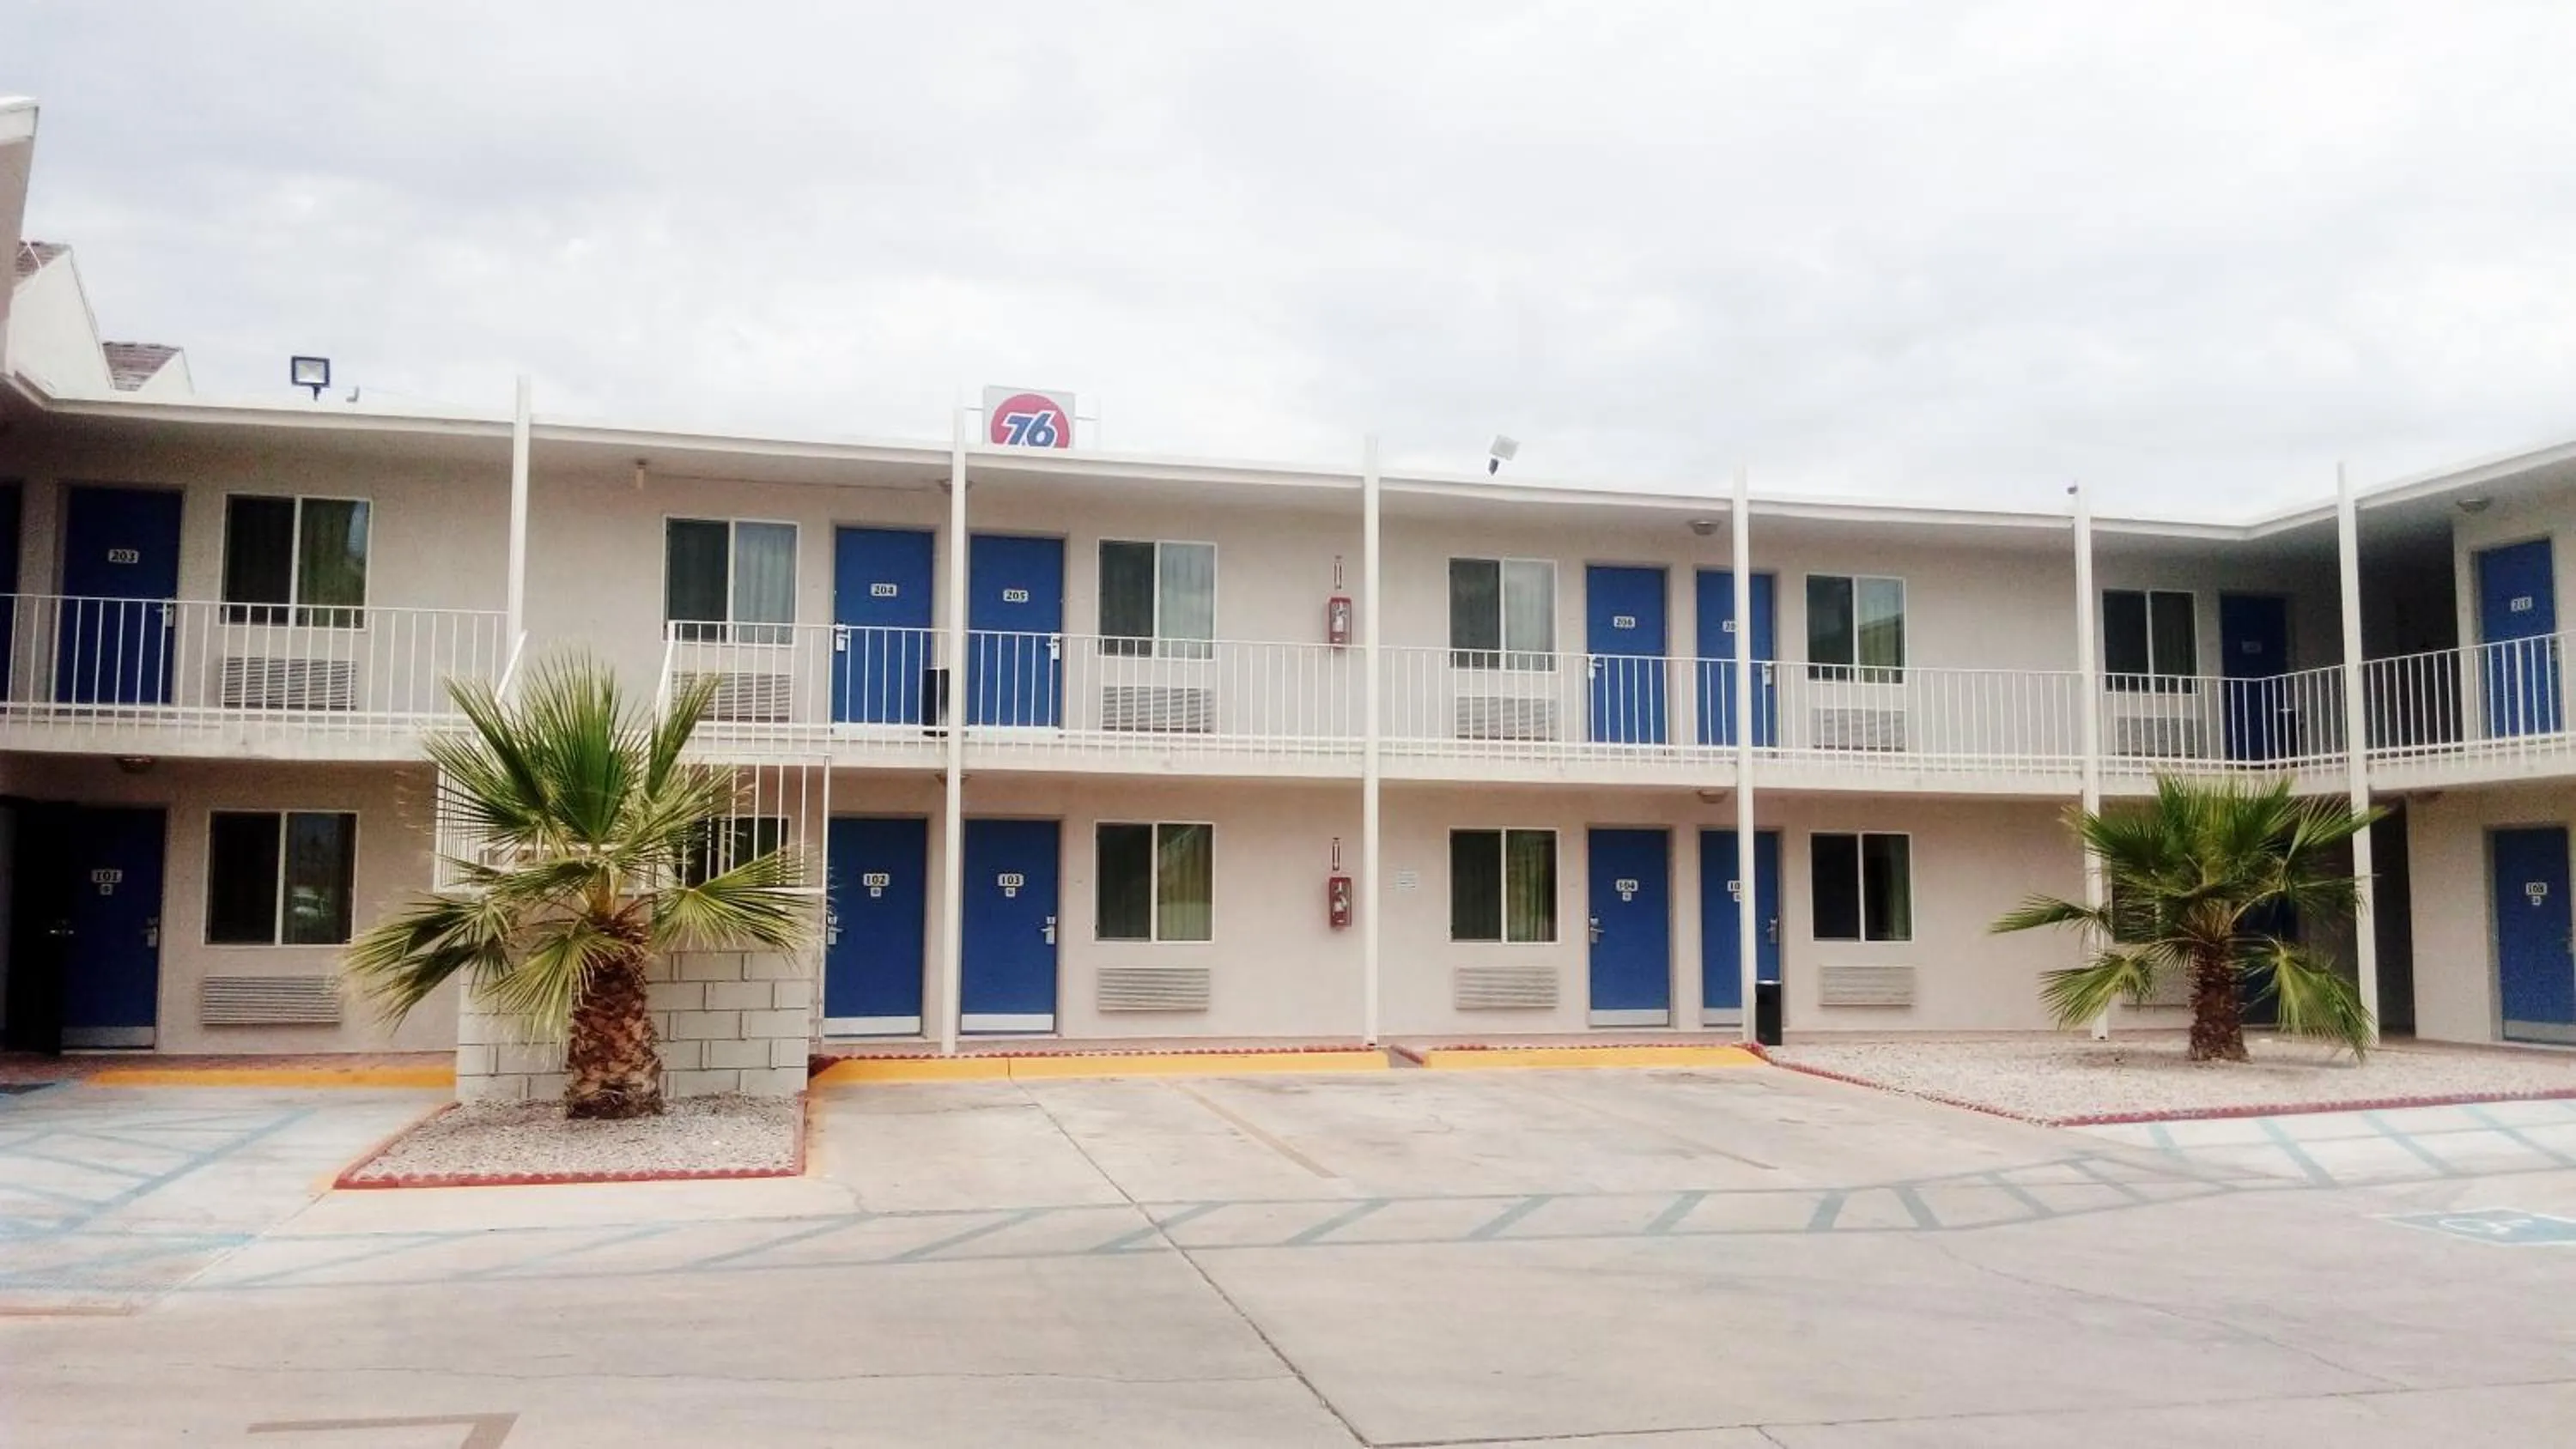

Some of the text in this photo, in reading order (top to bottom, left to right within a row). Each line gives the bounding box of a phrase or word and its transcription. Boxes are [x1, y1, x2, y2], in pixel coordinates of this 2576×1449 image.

[1003, 410, 1057, 447] 76
[112, 550, 134, 562] 203
[874, 585, 894, 595] 204
[1006, 591, 1026, 601] 205
[96, 870, 118, 882] 101
[866, 875, 886, 884] 102
[1002, 876, 1020, 885] 103
